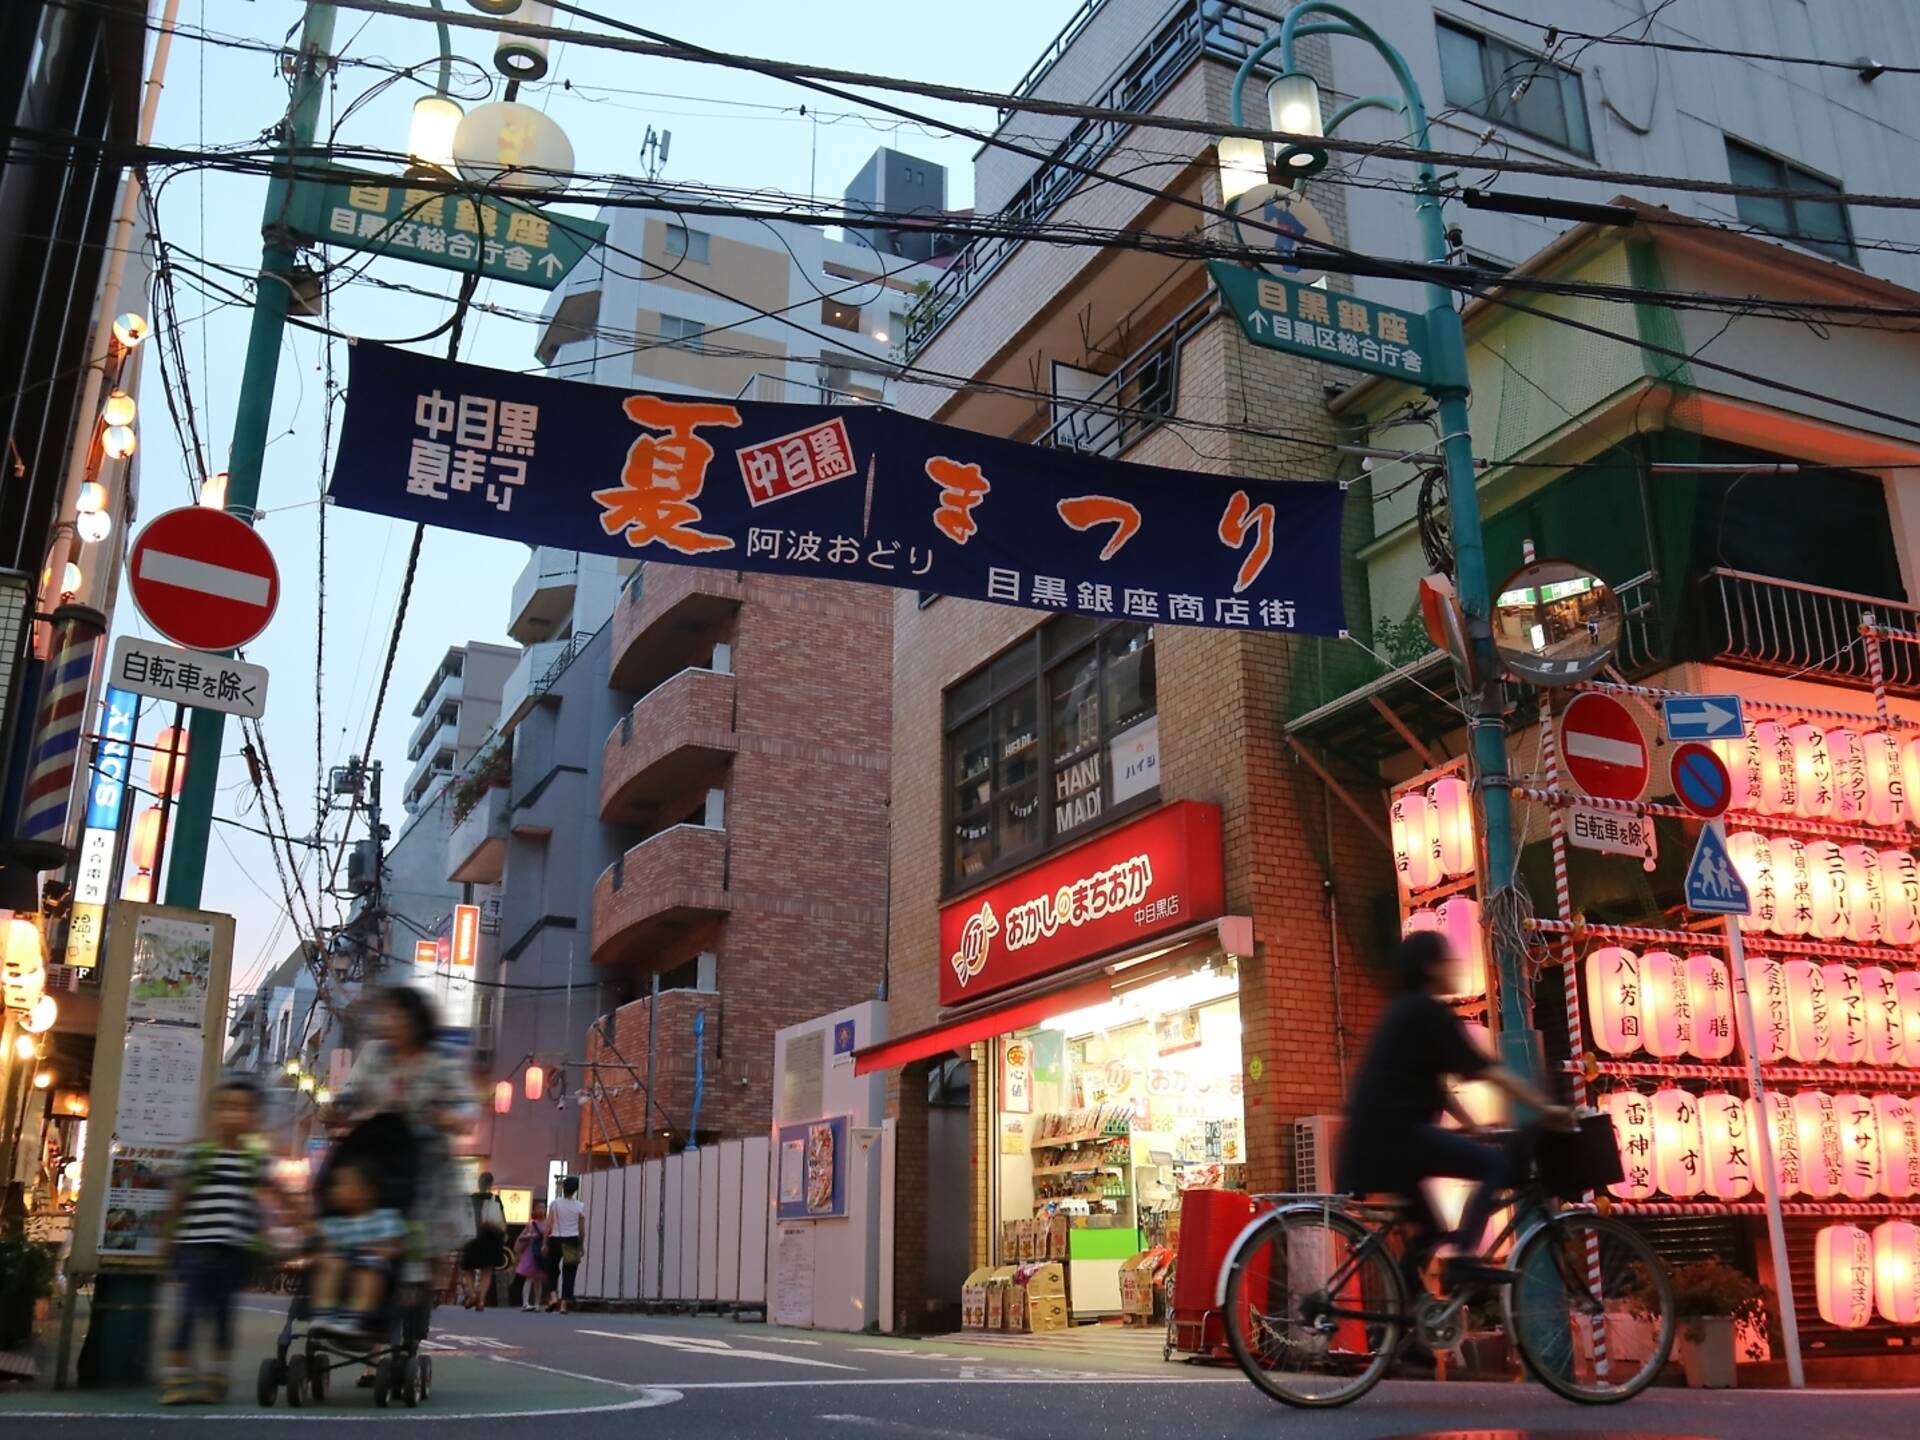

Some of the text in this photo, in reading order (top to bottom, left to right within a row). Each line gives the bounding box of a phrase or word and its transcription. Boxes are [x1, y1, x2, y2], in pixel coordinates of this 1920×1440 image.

[330, 207, 533, 272] 目黒区総合庁舎
[349, 184, 550, 249] 目黒銀座
[1257, 278, 1410, 346] 目黒銀座
[1272, 315, 1423, 373] 目黒区総合庁舎
[415, 389, 540, 457] 中目黒
[405, 437, 529, 512] 夏まつり
[591, 394, 744, 556] 夏
[744, 426, 851, 498] 中目黒
[746, 526, 935, 576] 阿波おどり
[986, 565, 1296, 628] 目黒銀座商店街
[122, 650, 257, 707] 自転車を除く
[95, 704, 130, 809] SONY
[1843, 732, 1867, 812] アトラスタワー
[1882, 734, 1904, 814] 中目黒GT
[1574, 812, 1651, 851] 自転車を除く
[1005, 853, 1153, 951] おかしのまちおか
[1133, 894, 1179, 926] 中目黒店
[1841, 971, 1864, 1047] ヤマトシ
[1878, 977, 1902, 1051] ヤマトシ
[1624, 1101, 1649, 1188] 雷神堂
[1722, 1101, 1749, 1182] すし太一
[1851, 1109, 1873, 1180] アサミ
